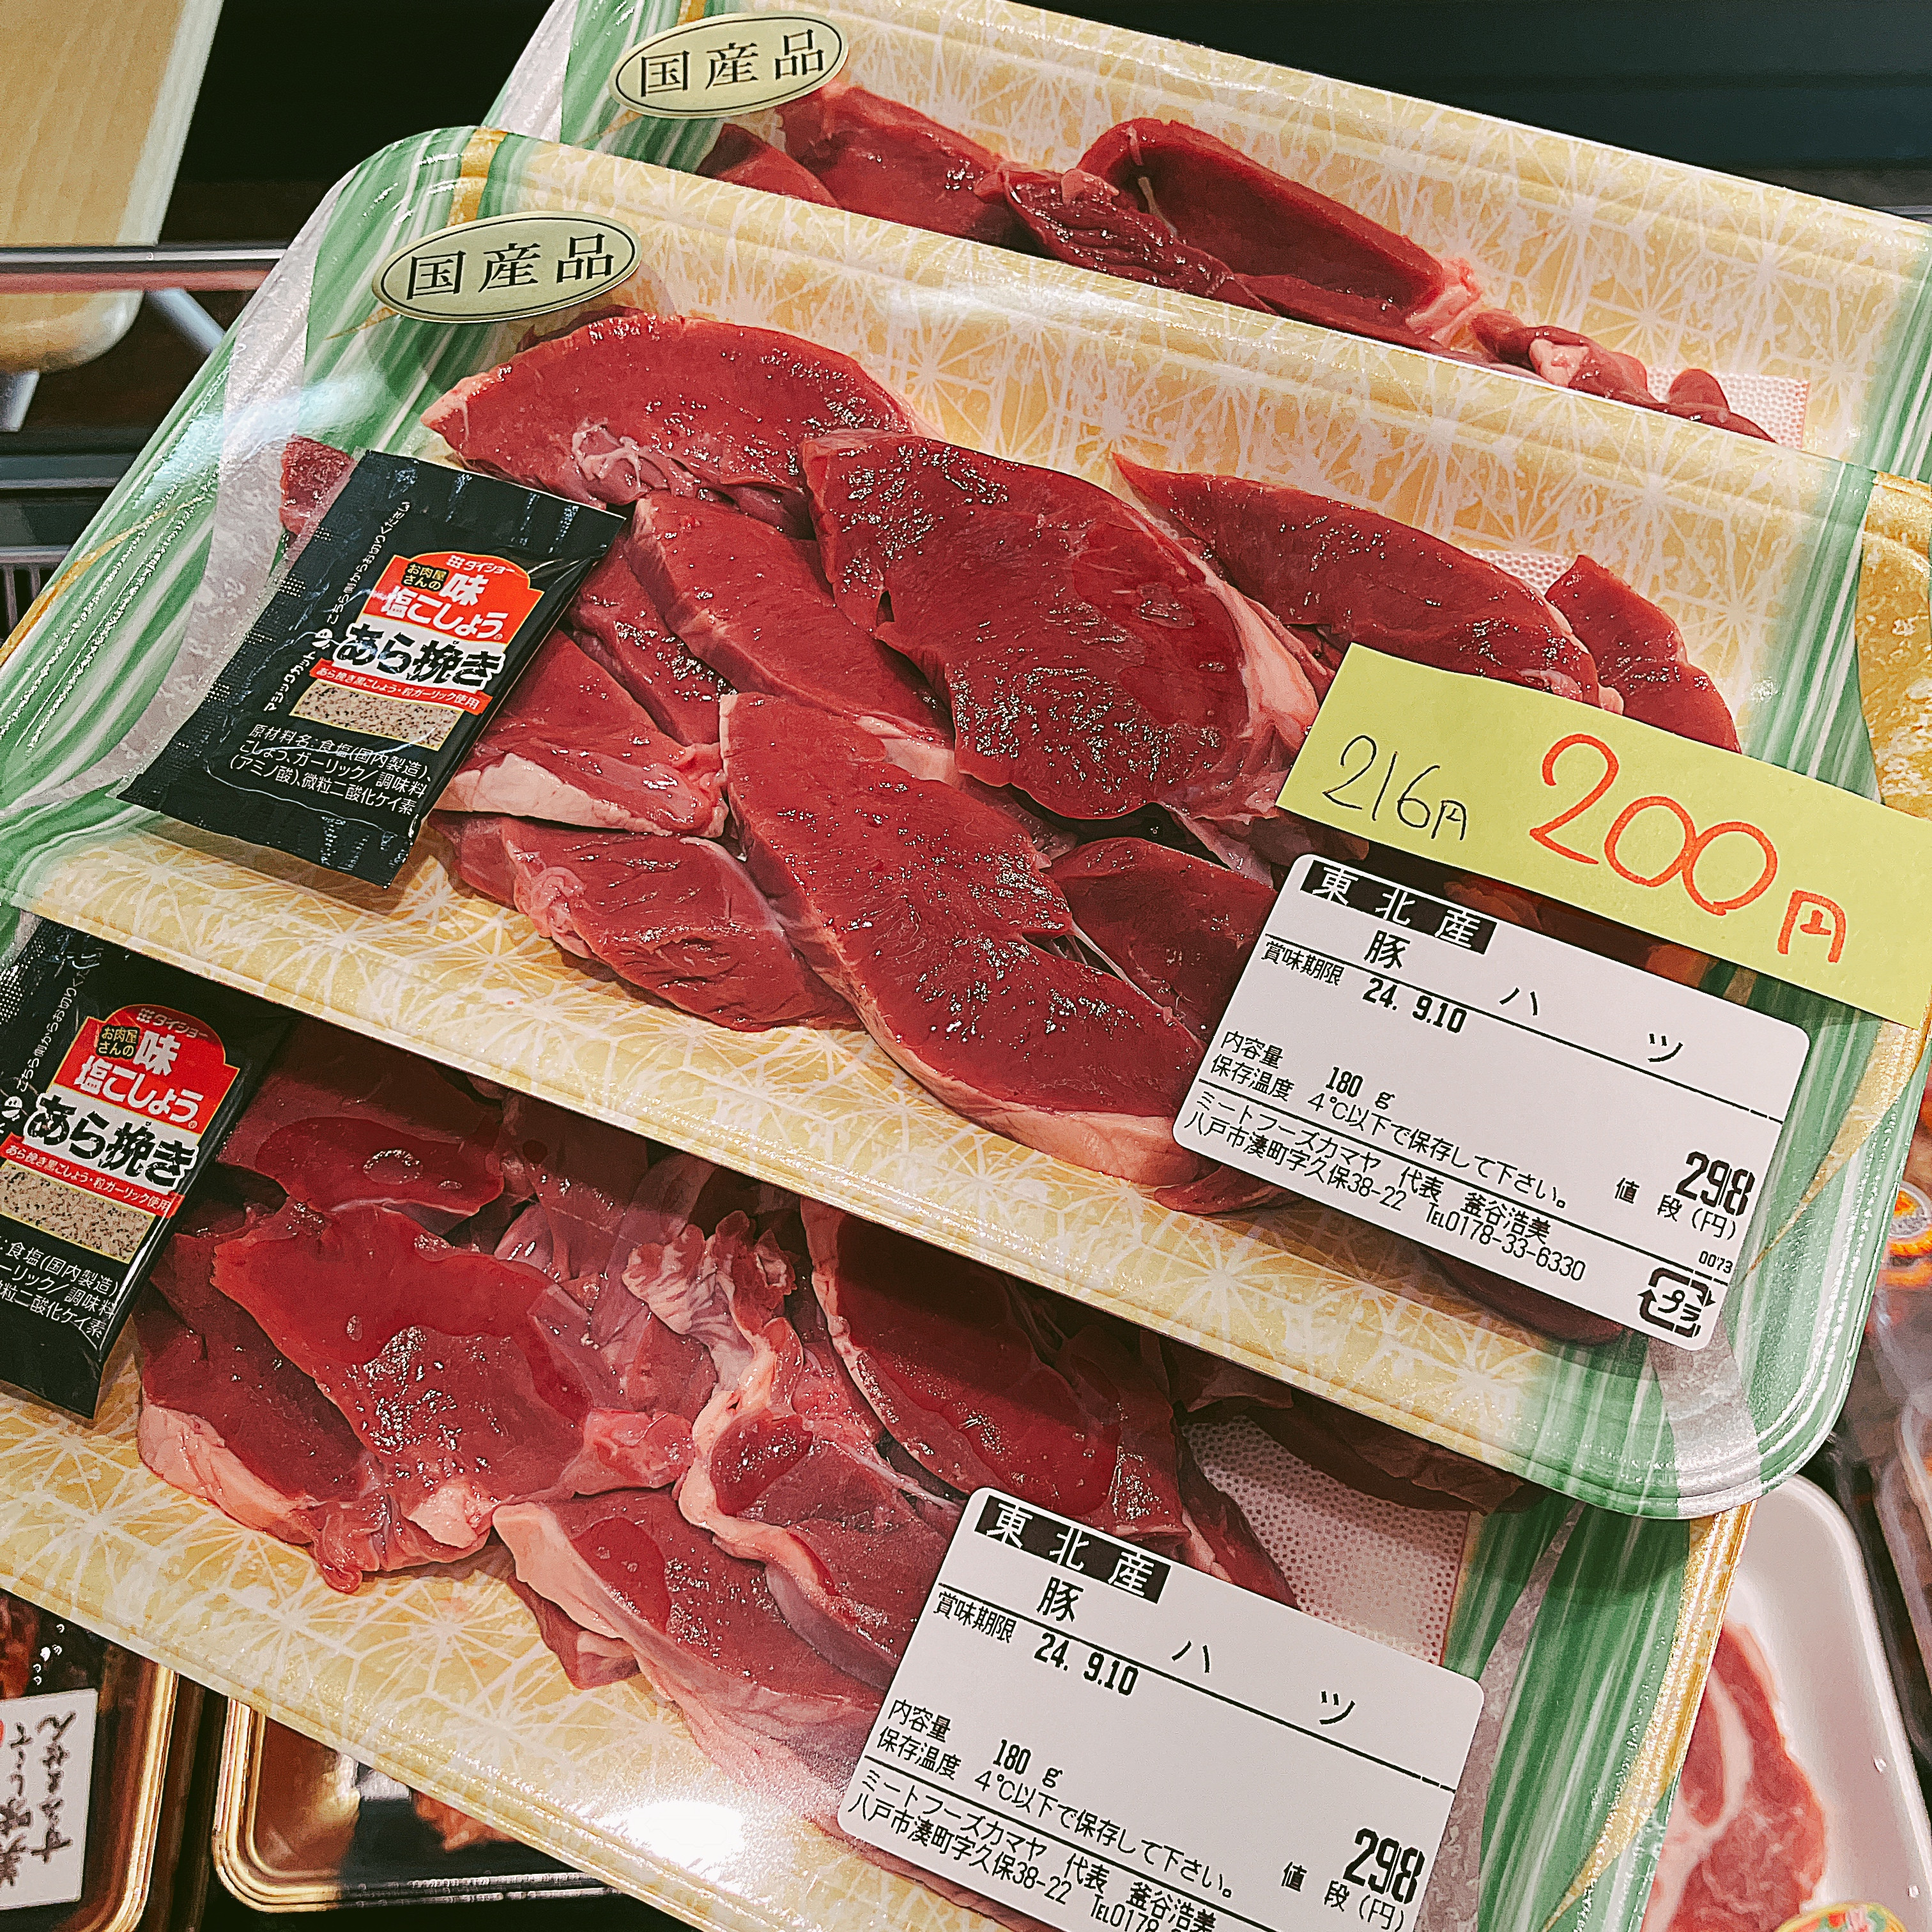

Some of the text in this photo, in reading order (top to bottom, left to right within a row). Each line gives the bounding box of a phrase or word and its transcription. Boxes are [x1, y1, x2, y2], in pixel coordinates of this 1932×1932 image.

[640, 29, 824, 97] 国産品
[406, 233, 616, 300] 国産品
[403, 574, 441, 590] さんの
[407, 564, 447, 581] お肉屋
[439, 573, 489, 606] 味
[463, 560, 515, 574] ダイショー
[264, 651, 316, 711] マジックカット
[334, 622, 503, 687] あら挽き
[1322, 735, 1467, 841] 216円
[1530, 733, 1846, 964] 200円
[1313, 866, 1480, 948] 東北産
[1261, 941, 1344, 986] 賞味期限
[98, 1041, 134, 1057] さんの
[102, 1028, 137, 1044] お肉屋
[133, 1030, 181, 1076] 味
[153, 1013, 208, 1038] ダイショー
[1211, 1054, 1294, 1101] 保存温度
[1220, 1031, 1395, 1110] 内容量 180 g
[26, 1094, 195, 1188] あら挽き
[1184, 1111, 1407, 1211] 八戸市湊町字久保38-22
[1197, 1091, 1551, 1245] ミートフーズカマヤ 代表 釜谷浩美
[1675, 1151, 1755, 1216] 298
[0, 1280, 107, 1338] 粒二酸化ケイ素
[1657, 1289, 1701, 1321] プラ
[986, 1503, 1154, 1597] 東北産
[933, 1591, 1017, 1643] 賞味期限
[877, 1726, 961, 1780] 保存温度
[888, 1699, 1062, 1788] 内容量 180 g
[848, 1793, 1071, 1905] 八戸市湊町字久保38-22
[862, 1769, 1047, 1861] ミートフーズカマヤ
[1064, 1853, 1109, 1894] 代表
[1343, 1828, 1425, 1904] 298
